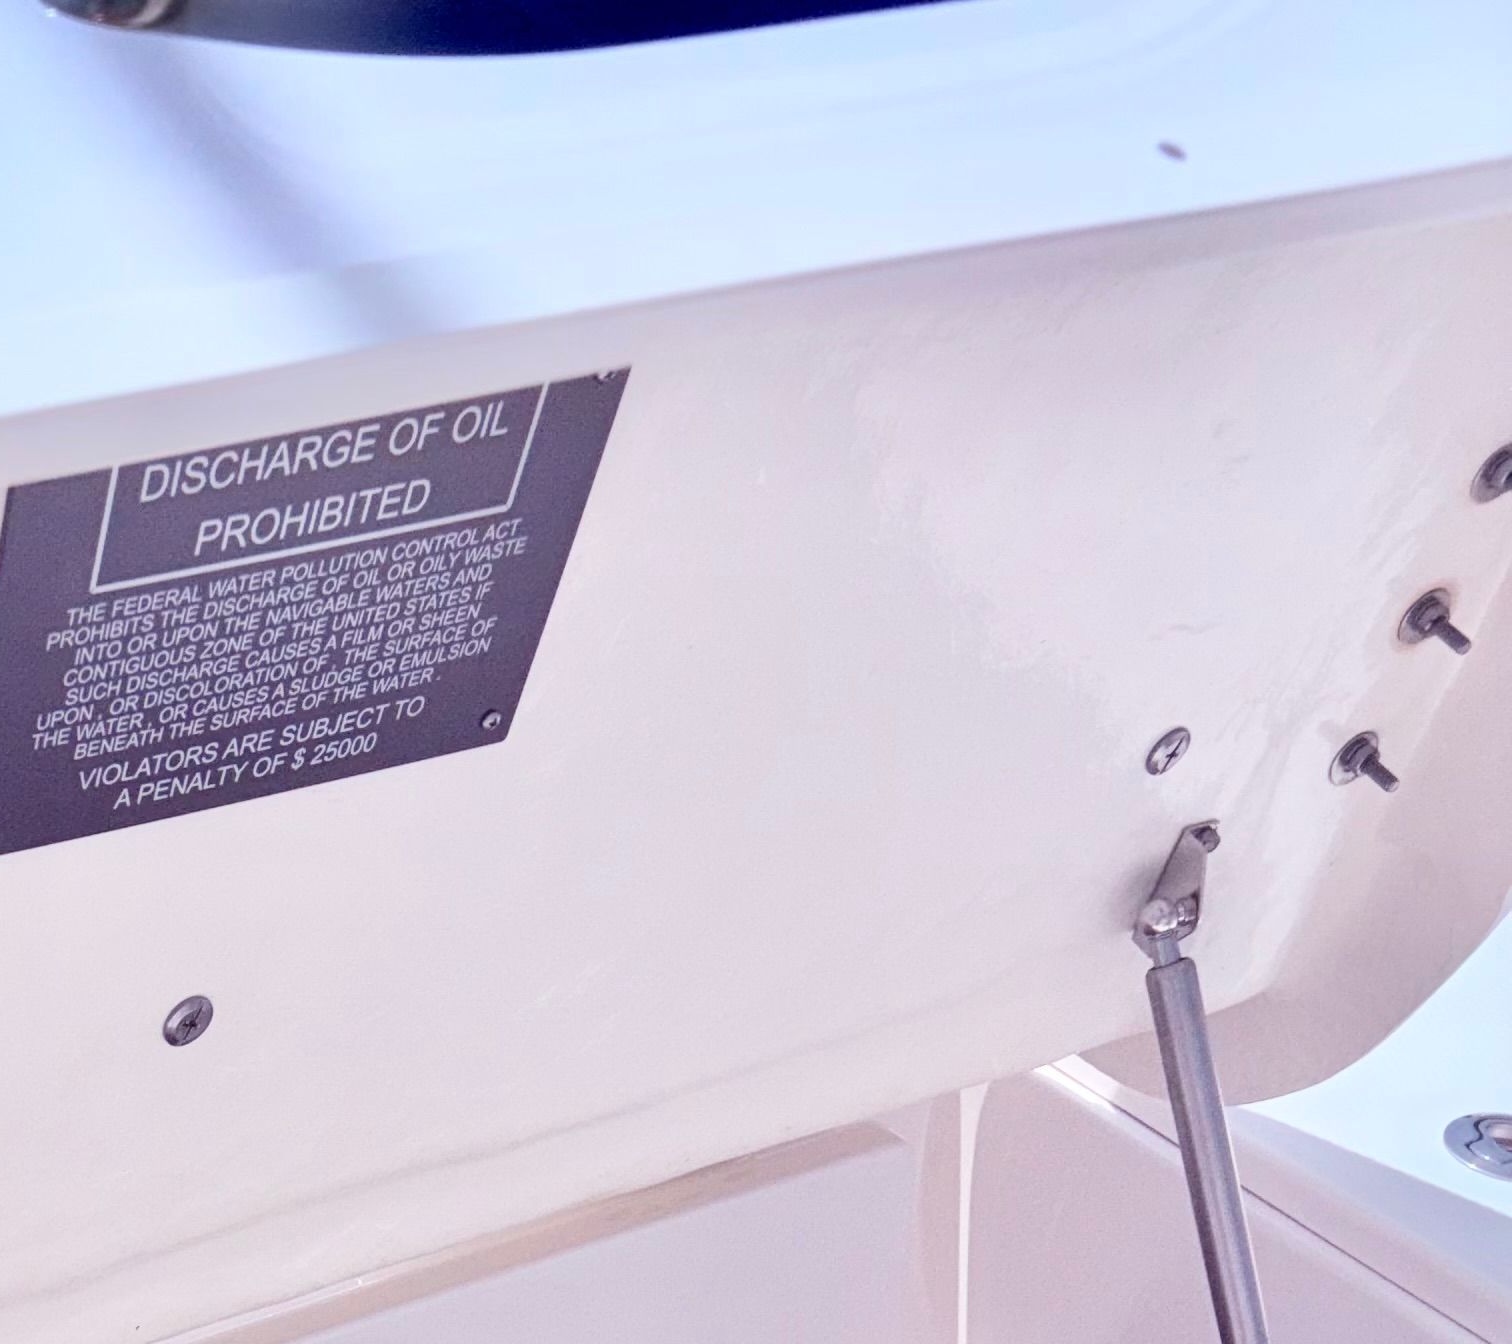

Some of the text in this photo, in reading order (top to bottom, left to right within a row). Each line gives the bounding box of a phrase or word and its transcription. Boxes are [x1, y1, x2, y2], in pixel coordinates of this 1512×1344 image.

[140, 400, 508, 503] DISCHARGE OF OIL
[194, 479, 431, 556] PROHIBITED
[46, 537, 528, 650] PROHIBITS THE DISCHARGE OF OIL OR OILY WASTE
[67, 518, 523, 627] THE FEDERAL WATER POLLUTION CONTROL ACT
[74, 564, 492, 665] INTO OR UPON THE NAVIGABLE WATERS AND
[63, 581, 494, 687] CONTIGUOUS ZONE OF THE UNITED STATES IF
[65, 601, 482, 706] SUCH DISCHARGE CAUSES A FILM OR SHEEN
[109, 696, 139, 716] OR
[143, 662, 298, 709] DISCOLORATION
[345, 645, 381, 666] THE
[383, 625, 467, 657] SURFACE
[471, 617, 499, 637] OF
[32, 727, 72, 750] THE
[159, 703, 189, 724] OR
[192, 685, 270, 716] CAUSES
[272, 683, 285, 700] A
[288, 665, 364, 696] SLUDGE
[368, 659, 396, 678] OR
[399, 637, 493, 672] EMULSION
[74, 727, 165, 760] BENEATH
[169, 718, 207, 739] THE
[210, 700, 296, 731] SURFACE
[302, 692, 328, 710] OF
[333, 683, 368, 703] THE
[79, 696, 426, 790] VIOLATORS ARE SUBJECT TO
[113, 733, 377, 810] A PENALTY OF $ 25000
